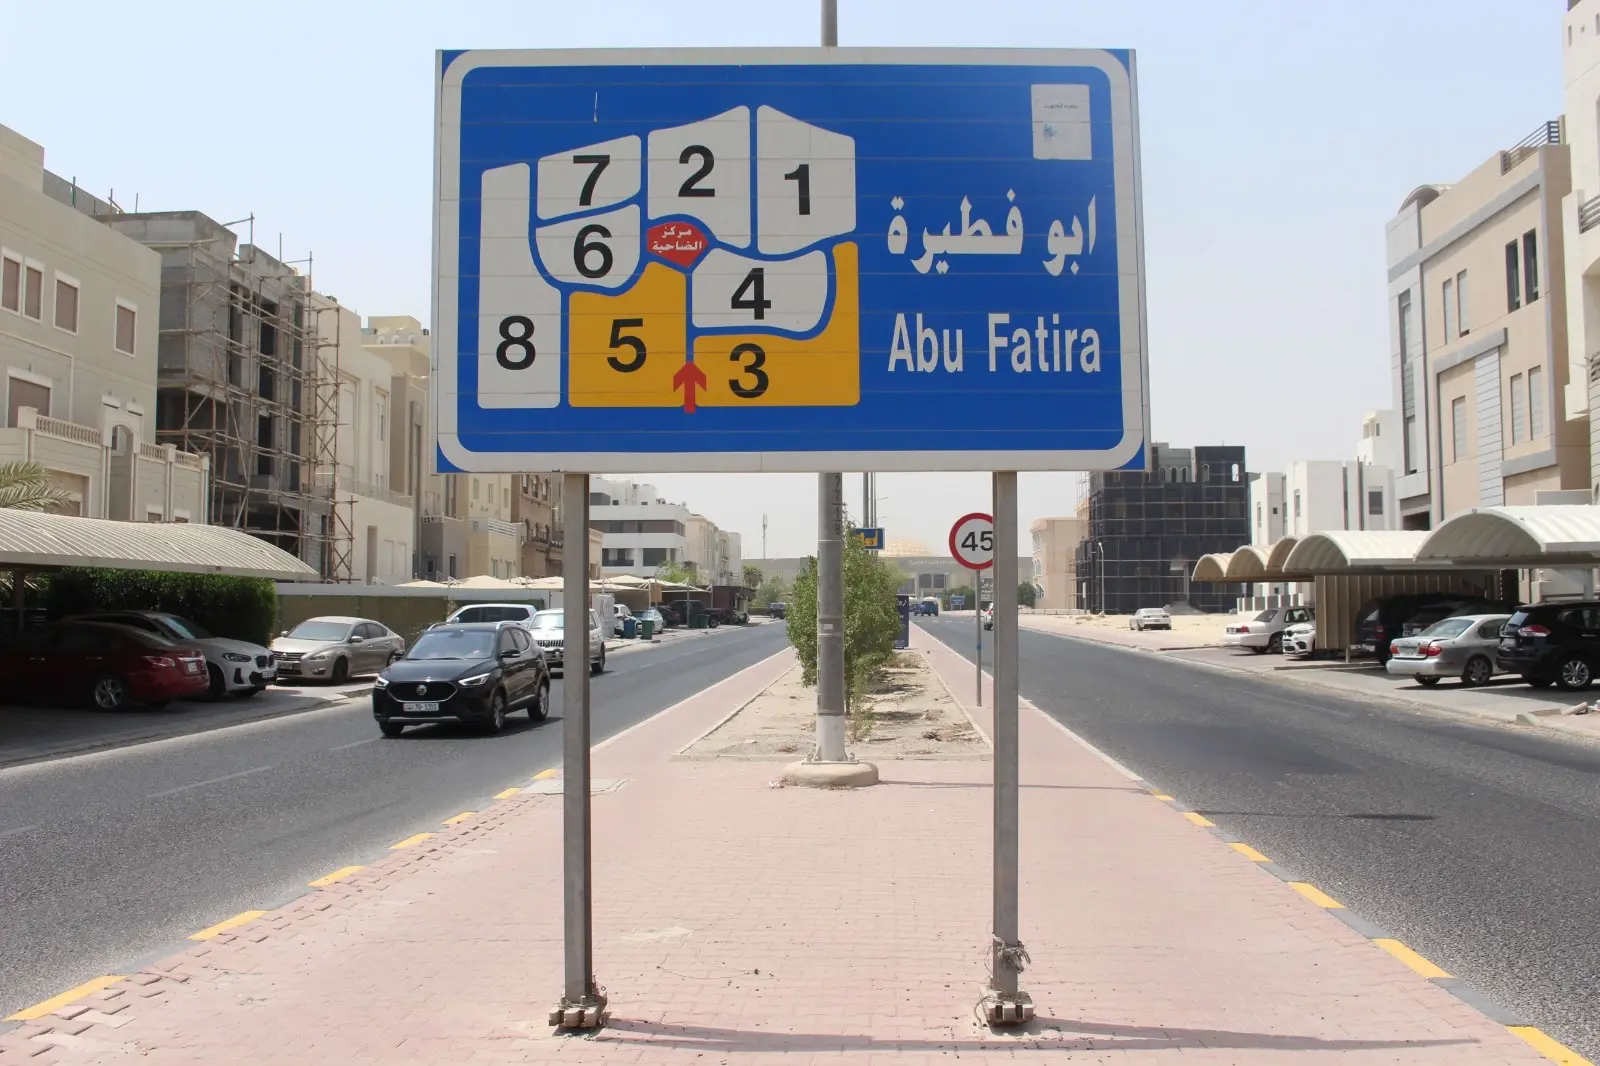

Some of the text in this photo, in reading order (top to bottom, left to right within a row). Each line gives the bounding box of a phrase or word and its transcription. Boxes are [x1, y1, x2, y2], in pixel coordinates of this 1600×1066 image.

[573, 155, 610, 206] 7
[678, 145, 715, 197] 2
[784, 164, 810, 215] 1
[573, 224, 613, 279] 6
[652, 240, 703, 253] الضاحية
[661, 225, 692, 238] مركز
[887, 188, 1097, 276] ابو فطيرة
[731, 267, 771, 320] 4
[496, 315, 536, 370] 8
[607, 318, 647, 373] 5
[887, 313, 1101, 373] Abu Fatira
[728, 343, 769, 399] 3
[961, 531, 993, 552] 45
